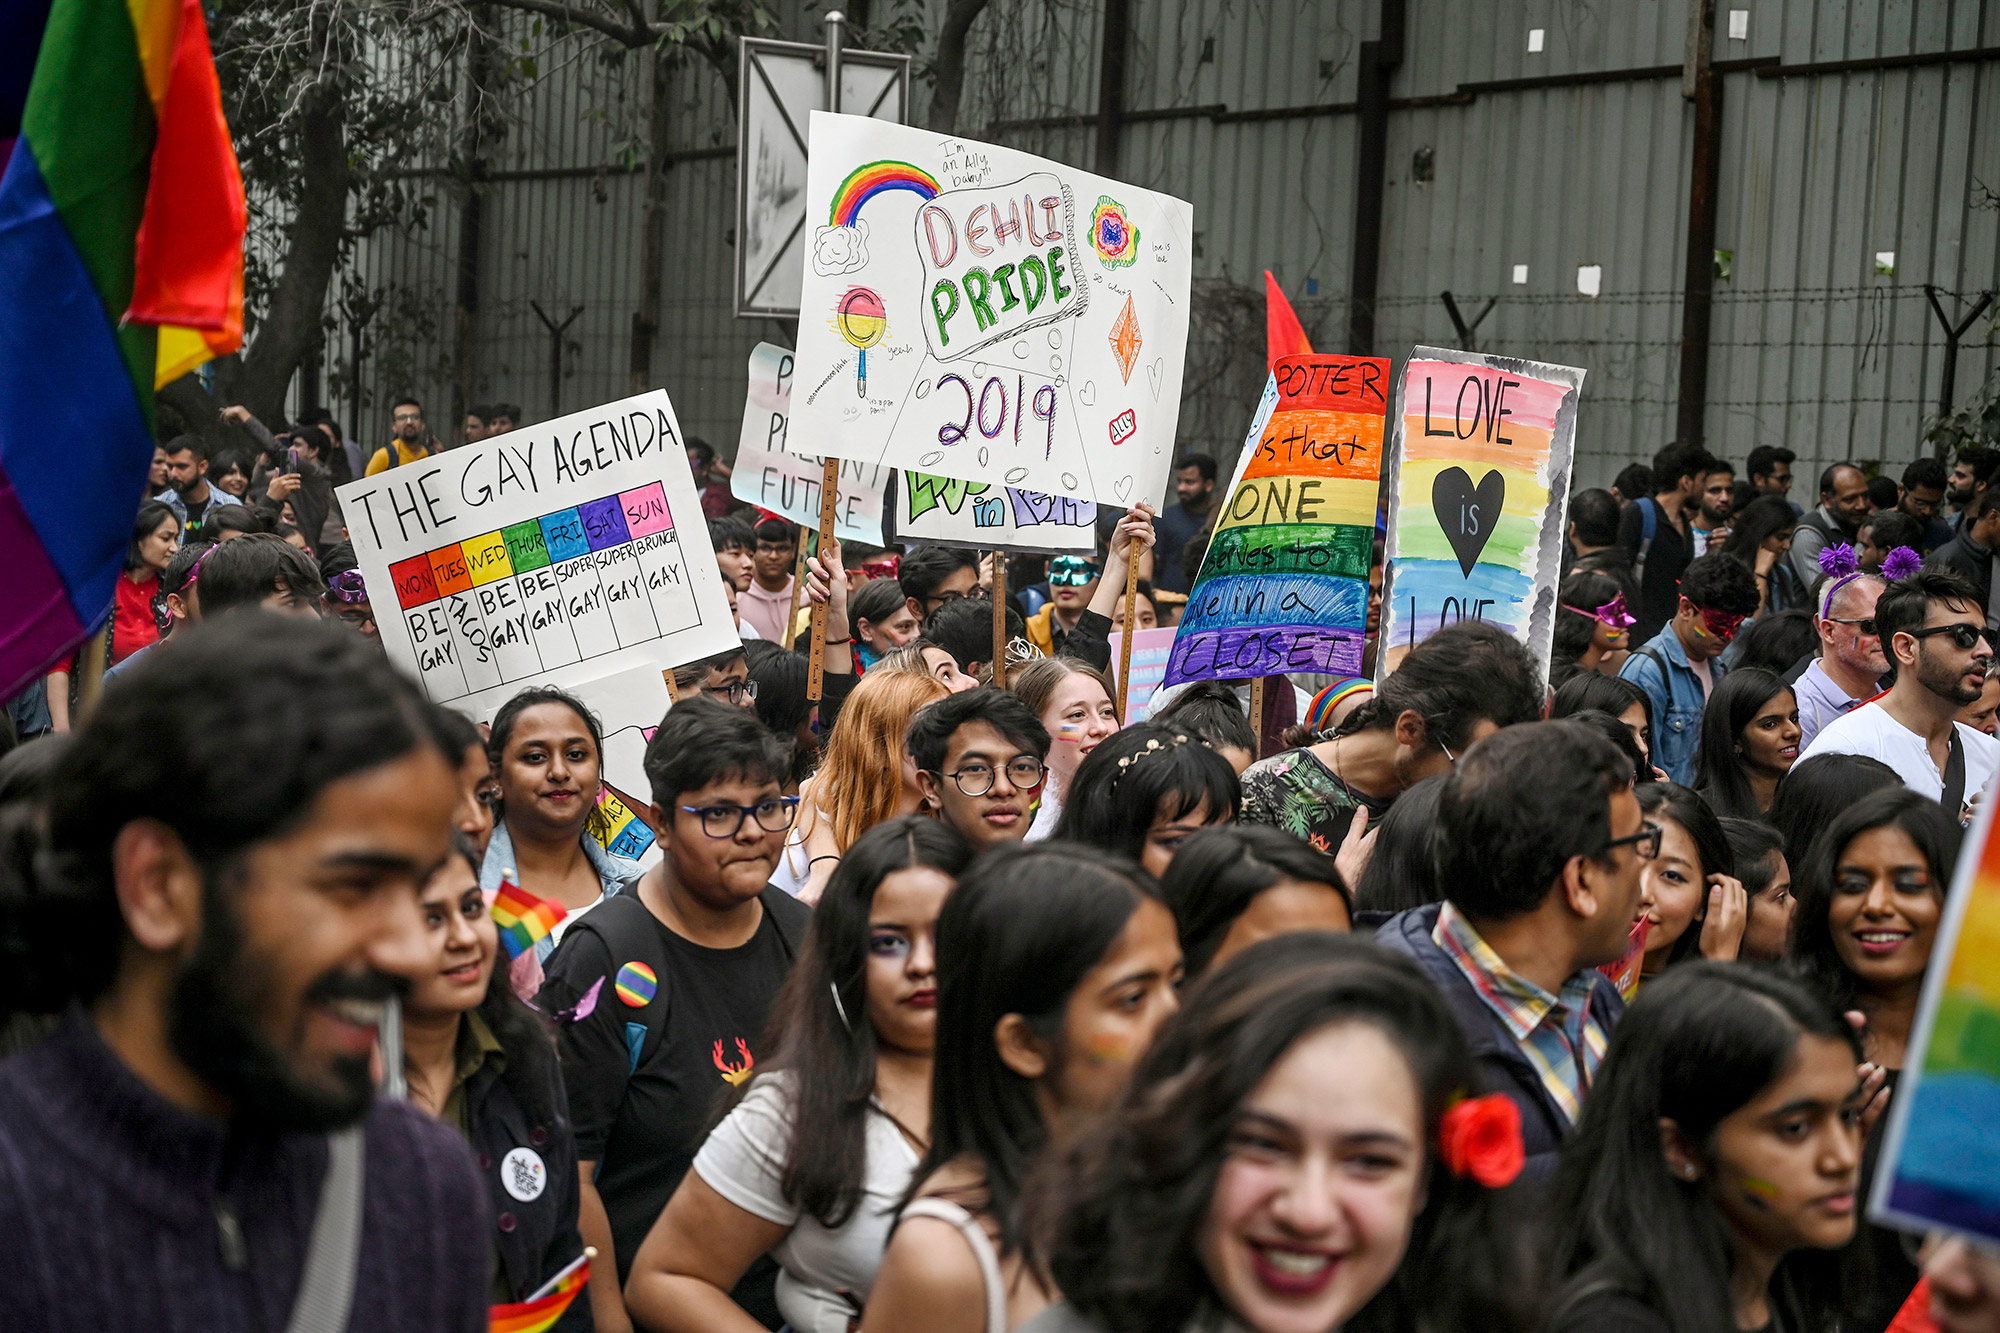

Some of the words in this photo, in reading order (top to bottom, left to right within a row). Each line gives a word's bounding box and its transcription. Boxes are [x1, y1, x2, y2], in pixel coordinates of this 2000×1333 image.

[938, 139, 965, 157] I'm
[943, 159, 958, 172] an
[923, 194, 1064, 268] DEHLI
[931, 246, 1072, 347] PRIDE
[888, 344, 913, 361] yeah
[1278, 362, 1385, 403] POTTER
[937, 373, 1057, 461] 2019
[1111, 411, 1133, 441] ALLY
[1425, 376, 1520, 445] LOVE
[1281, 424, 1367, 466] that
[351, 469, 456, 549] THE
[461, 442, 538, 507] GAY
[553, 408, 678, 484] AGENDA
[973, 496, 1004, 528] in
[1231, 478, 1326, 528] ONE
[1460, 494, 1480, 536] is
[398, 568, 432, 599] MON
[434, 558, 465, 584] TUES
[466, 545, 505, 570] WED
[507, 533, 544, 558] THUR
[550, 520, 582, 548] FRI
[586, 508, 619, 538] SAT
[627, 498, 664, 525] SUN
[595, 544, 636, 570] SUPER
[636, 530, 677, 556] BRUNCH
[1289, 537, 1330, 567] to
[521, 570, 556, 599] BE
[556, 556, 595, 583] SUPER
[649, 563, 680, 590] GAY
[479, 583, 516, 616] BE
[569, 583, 600, 618] GAY
[607, 575, 640, 602] GAY
[1234, 586, 1264, 614] in
[1281, 591, 1315, 614] a
[409, 607, 448, 643] BE
[449, 595, 491, 663] TACOS
[490, 613, 529, 648] GAY
[532, 598, 563, 630] GAY
[421, 640, 453, 671] GAY
[1181, 632, 1351, 677] CLOSET
